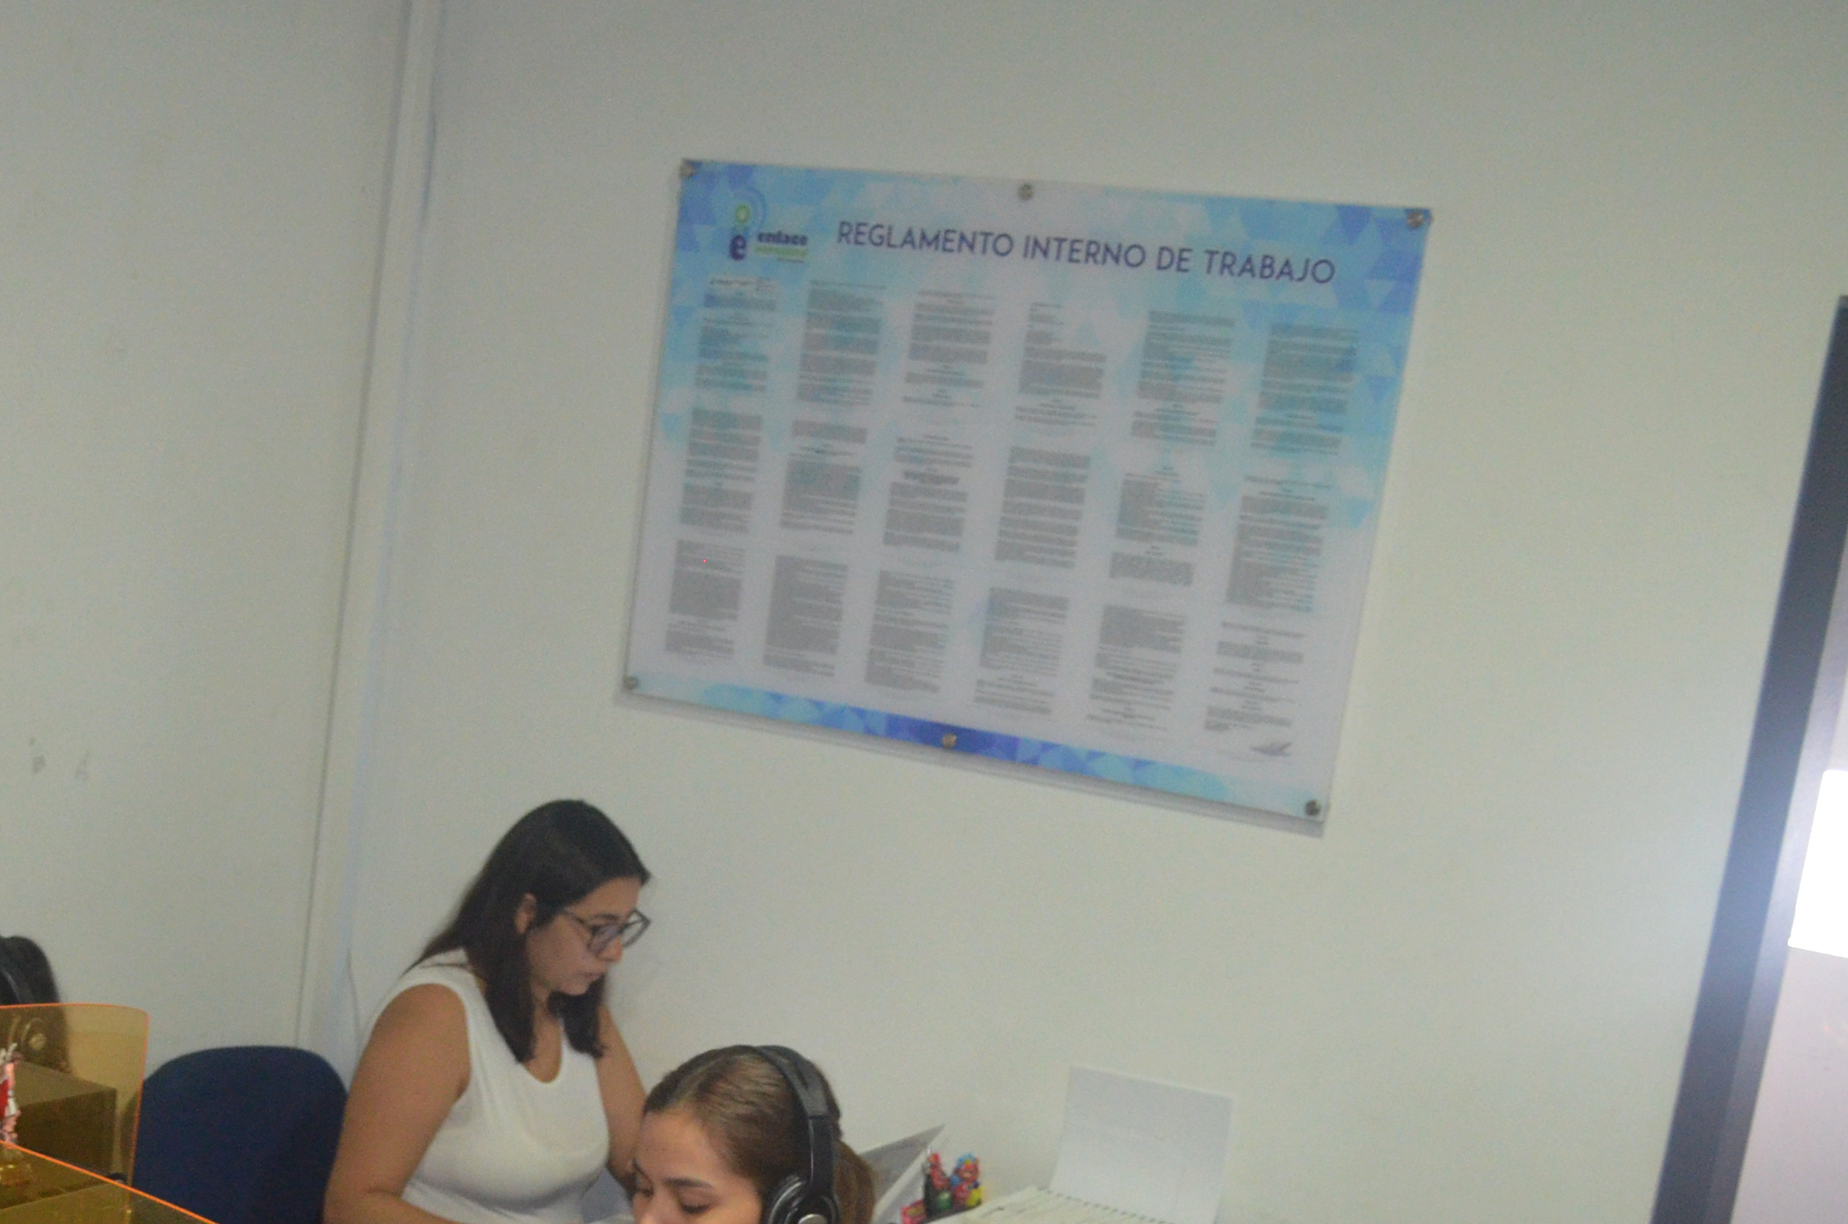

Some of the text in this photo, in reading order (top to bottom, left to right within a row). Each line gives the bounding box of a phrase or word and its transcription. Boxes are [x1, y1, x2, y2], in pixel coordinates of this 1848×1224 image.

[756, 229, 808, 246] enlace
[837, 221, 1336, 284] REGLAMENTO INTERNO DE TRABAJO
